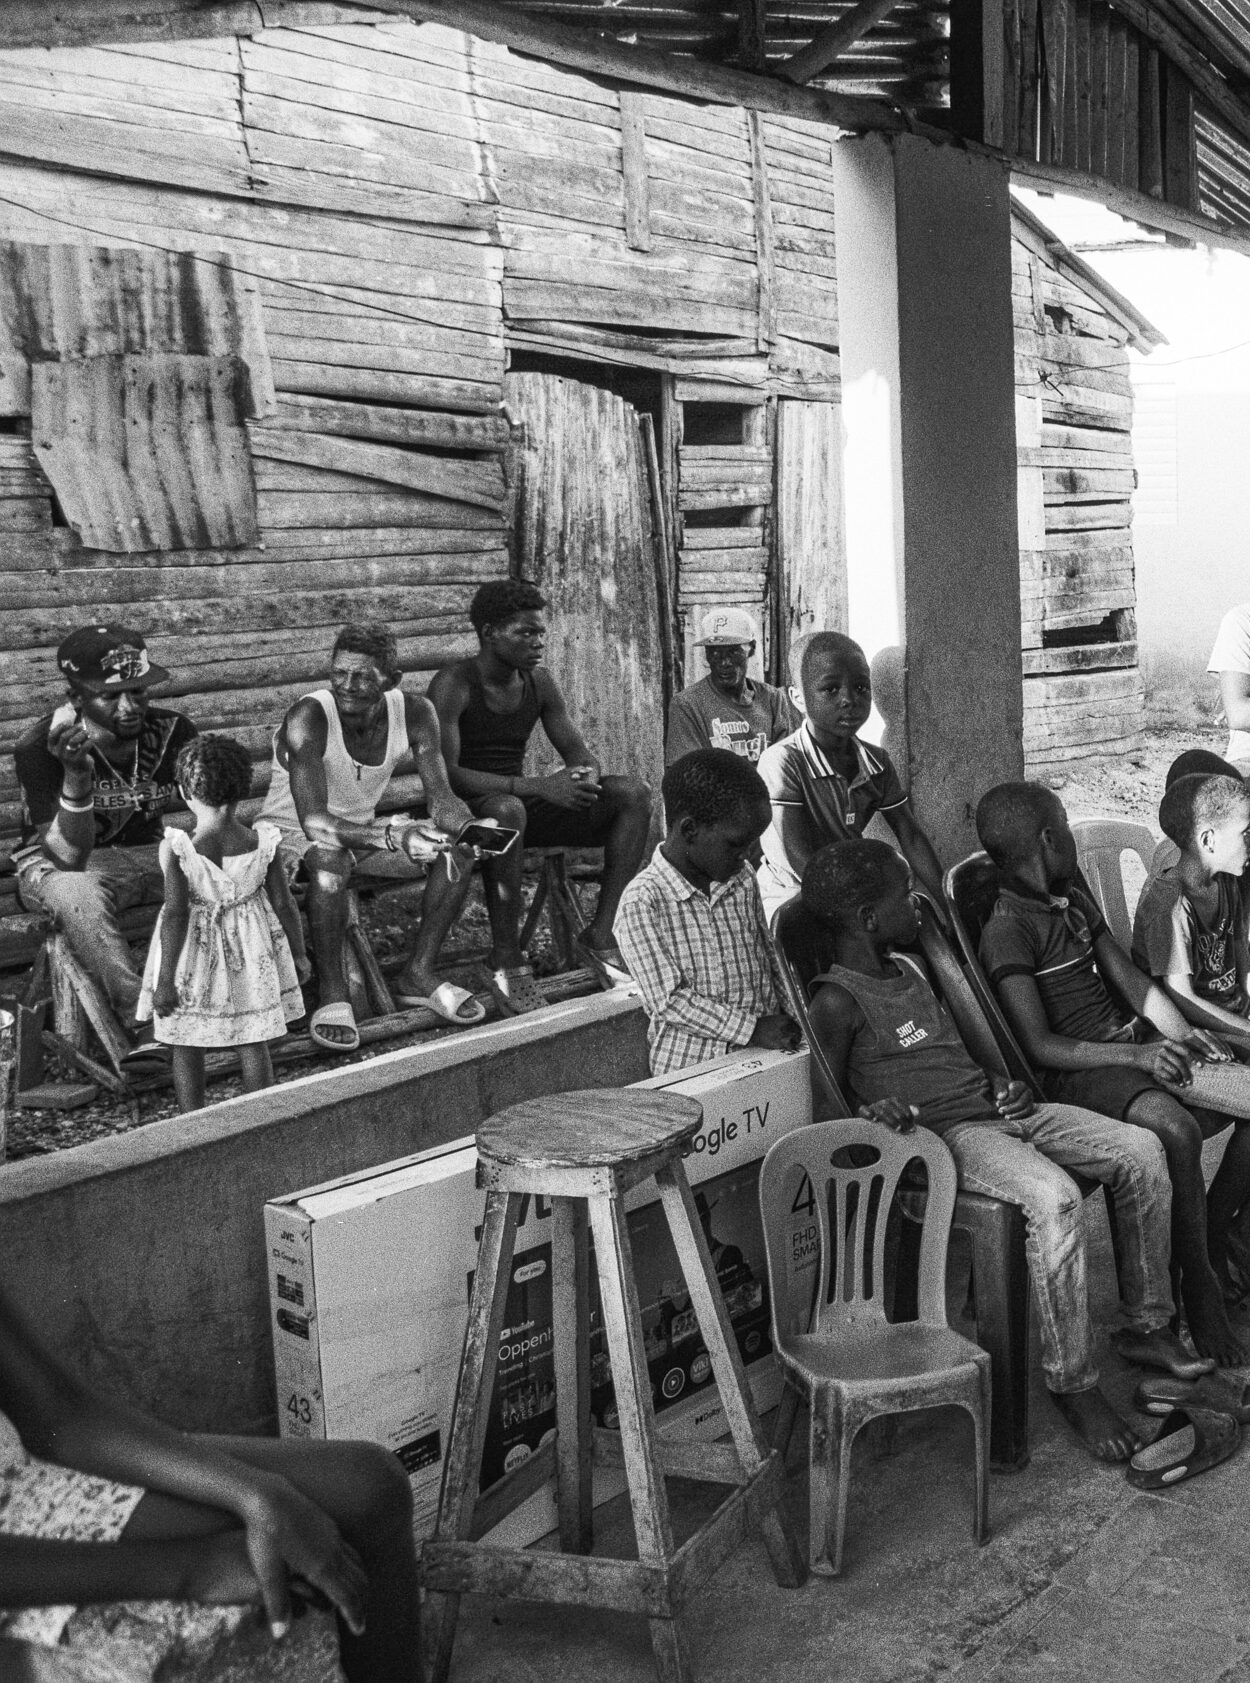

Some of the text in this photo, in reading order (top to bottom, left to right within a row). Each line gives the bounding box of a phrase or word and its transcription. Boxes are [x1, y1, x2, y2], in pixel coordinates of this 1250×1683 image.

[713, 615, 728, 634] P
[896, 1020, 916, 1038] SHOT
[899, 1028, 929, 1048] CALLER
[681, 1101, 770, 1159] ogle TV
[281, 1230, 295, 1243] JVC
[792, 1225, 817, 1248] FHD
[288, 1394, 313, 1425] 43
